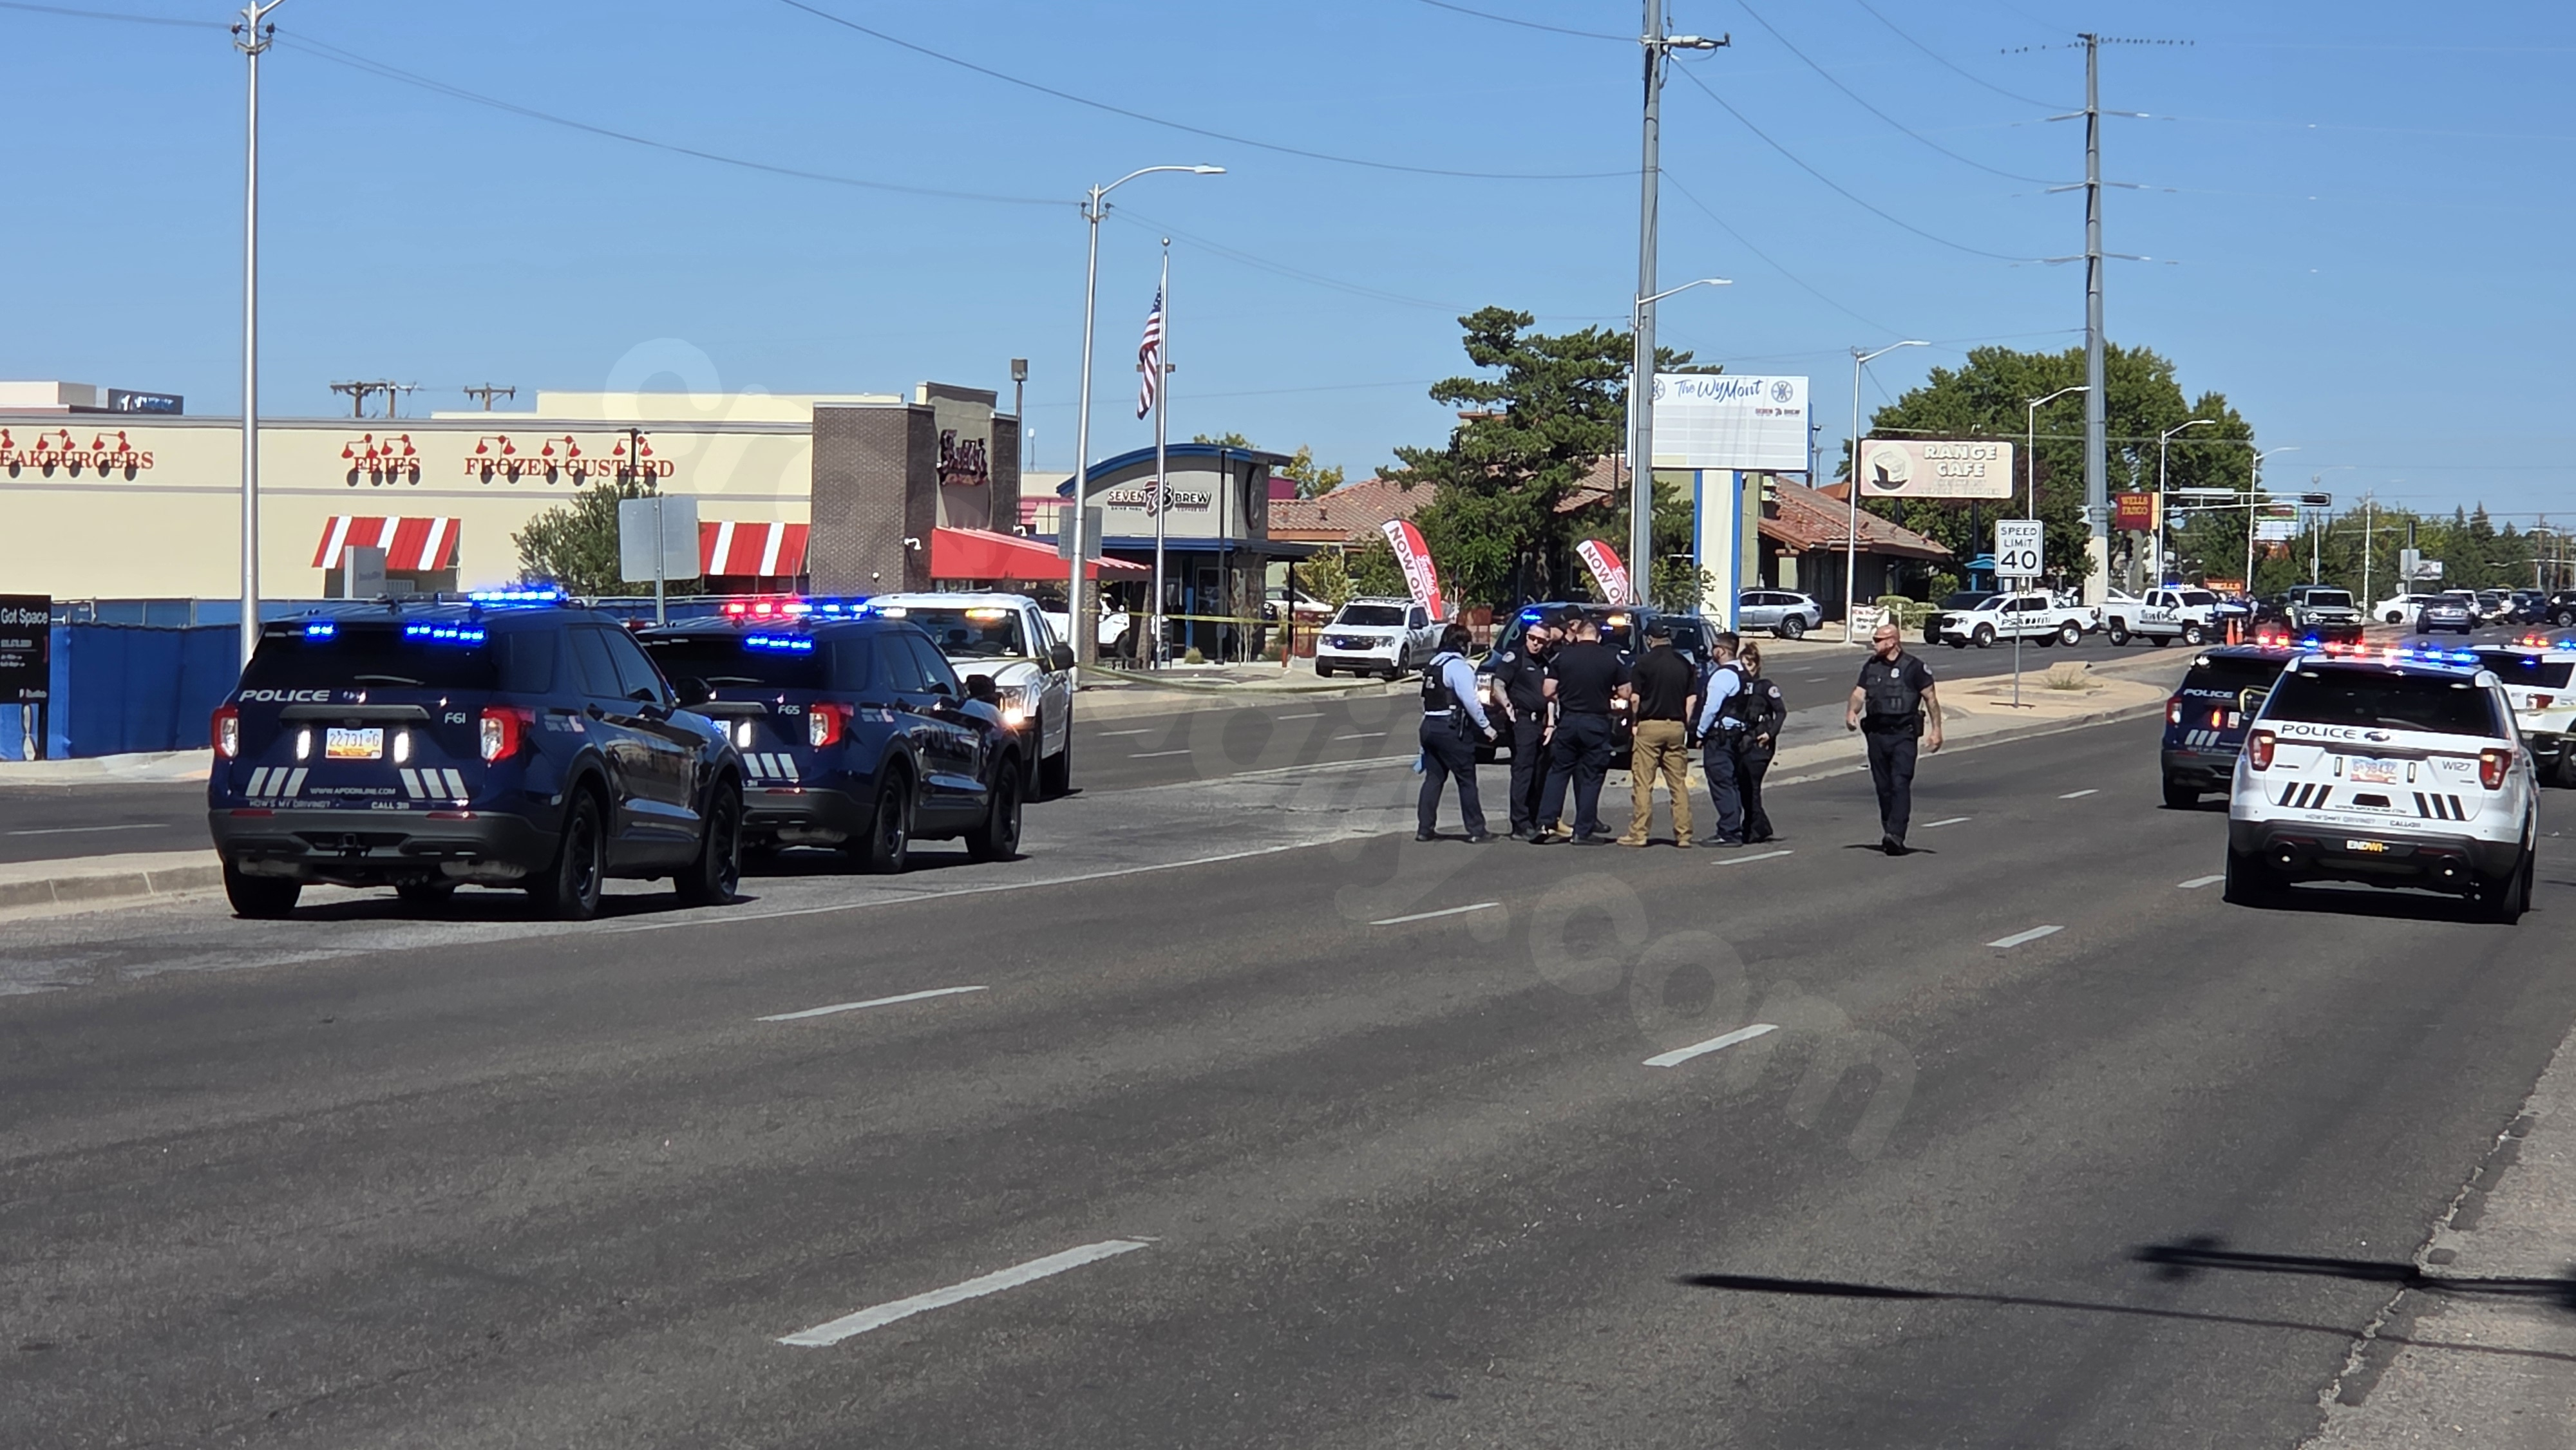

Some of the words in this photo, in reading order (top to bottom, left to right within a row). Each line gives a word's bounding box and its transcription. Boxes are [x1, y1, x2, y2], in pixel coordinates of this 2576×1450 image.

[1674, 379, 1696, 398] The
[1698, 379, 1764, 402] WyMont
[1924, 444, 1997, 460] RANGE
[354, 457, 421, 475] FRIES
[464, 458, 558, 476] FROZEN
[565, 459, 675, 478] CUSTARD
[1936, 462, 1985, 478] CAFE
[1108, 490, 1146, 503] SEVEN
[1175, 491, 1211, 504] BREW
[2121, 496, 2148, 505] WELLS
[2121, 506, 2148, 515] FARGO
[2001, 527, 2038, 536] SPEED
[1389, 526, 1415, 570] NOW
[2003, 539, 2033, 547] LIMIT
[1583, 546, 1613, 583] NOW
[2000, 550, 2037, 569] 40
[1, 607, 18, 624] Got
[19, 607, 48, 627] Space
[238, 689, 331, 702] POLICE
[2183, 688, 2234, 699] POLICE
[444, 712, 466, 724] F61
[329, 732, 365, 748] 22731
[2280, 724, 2357, 740] POLICE
[371, 801, 394, 809] CALL
